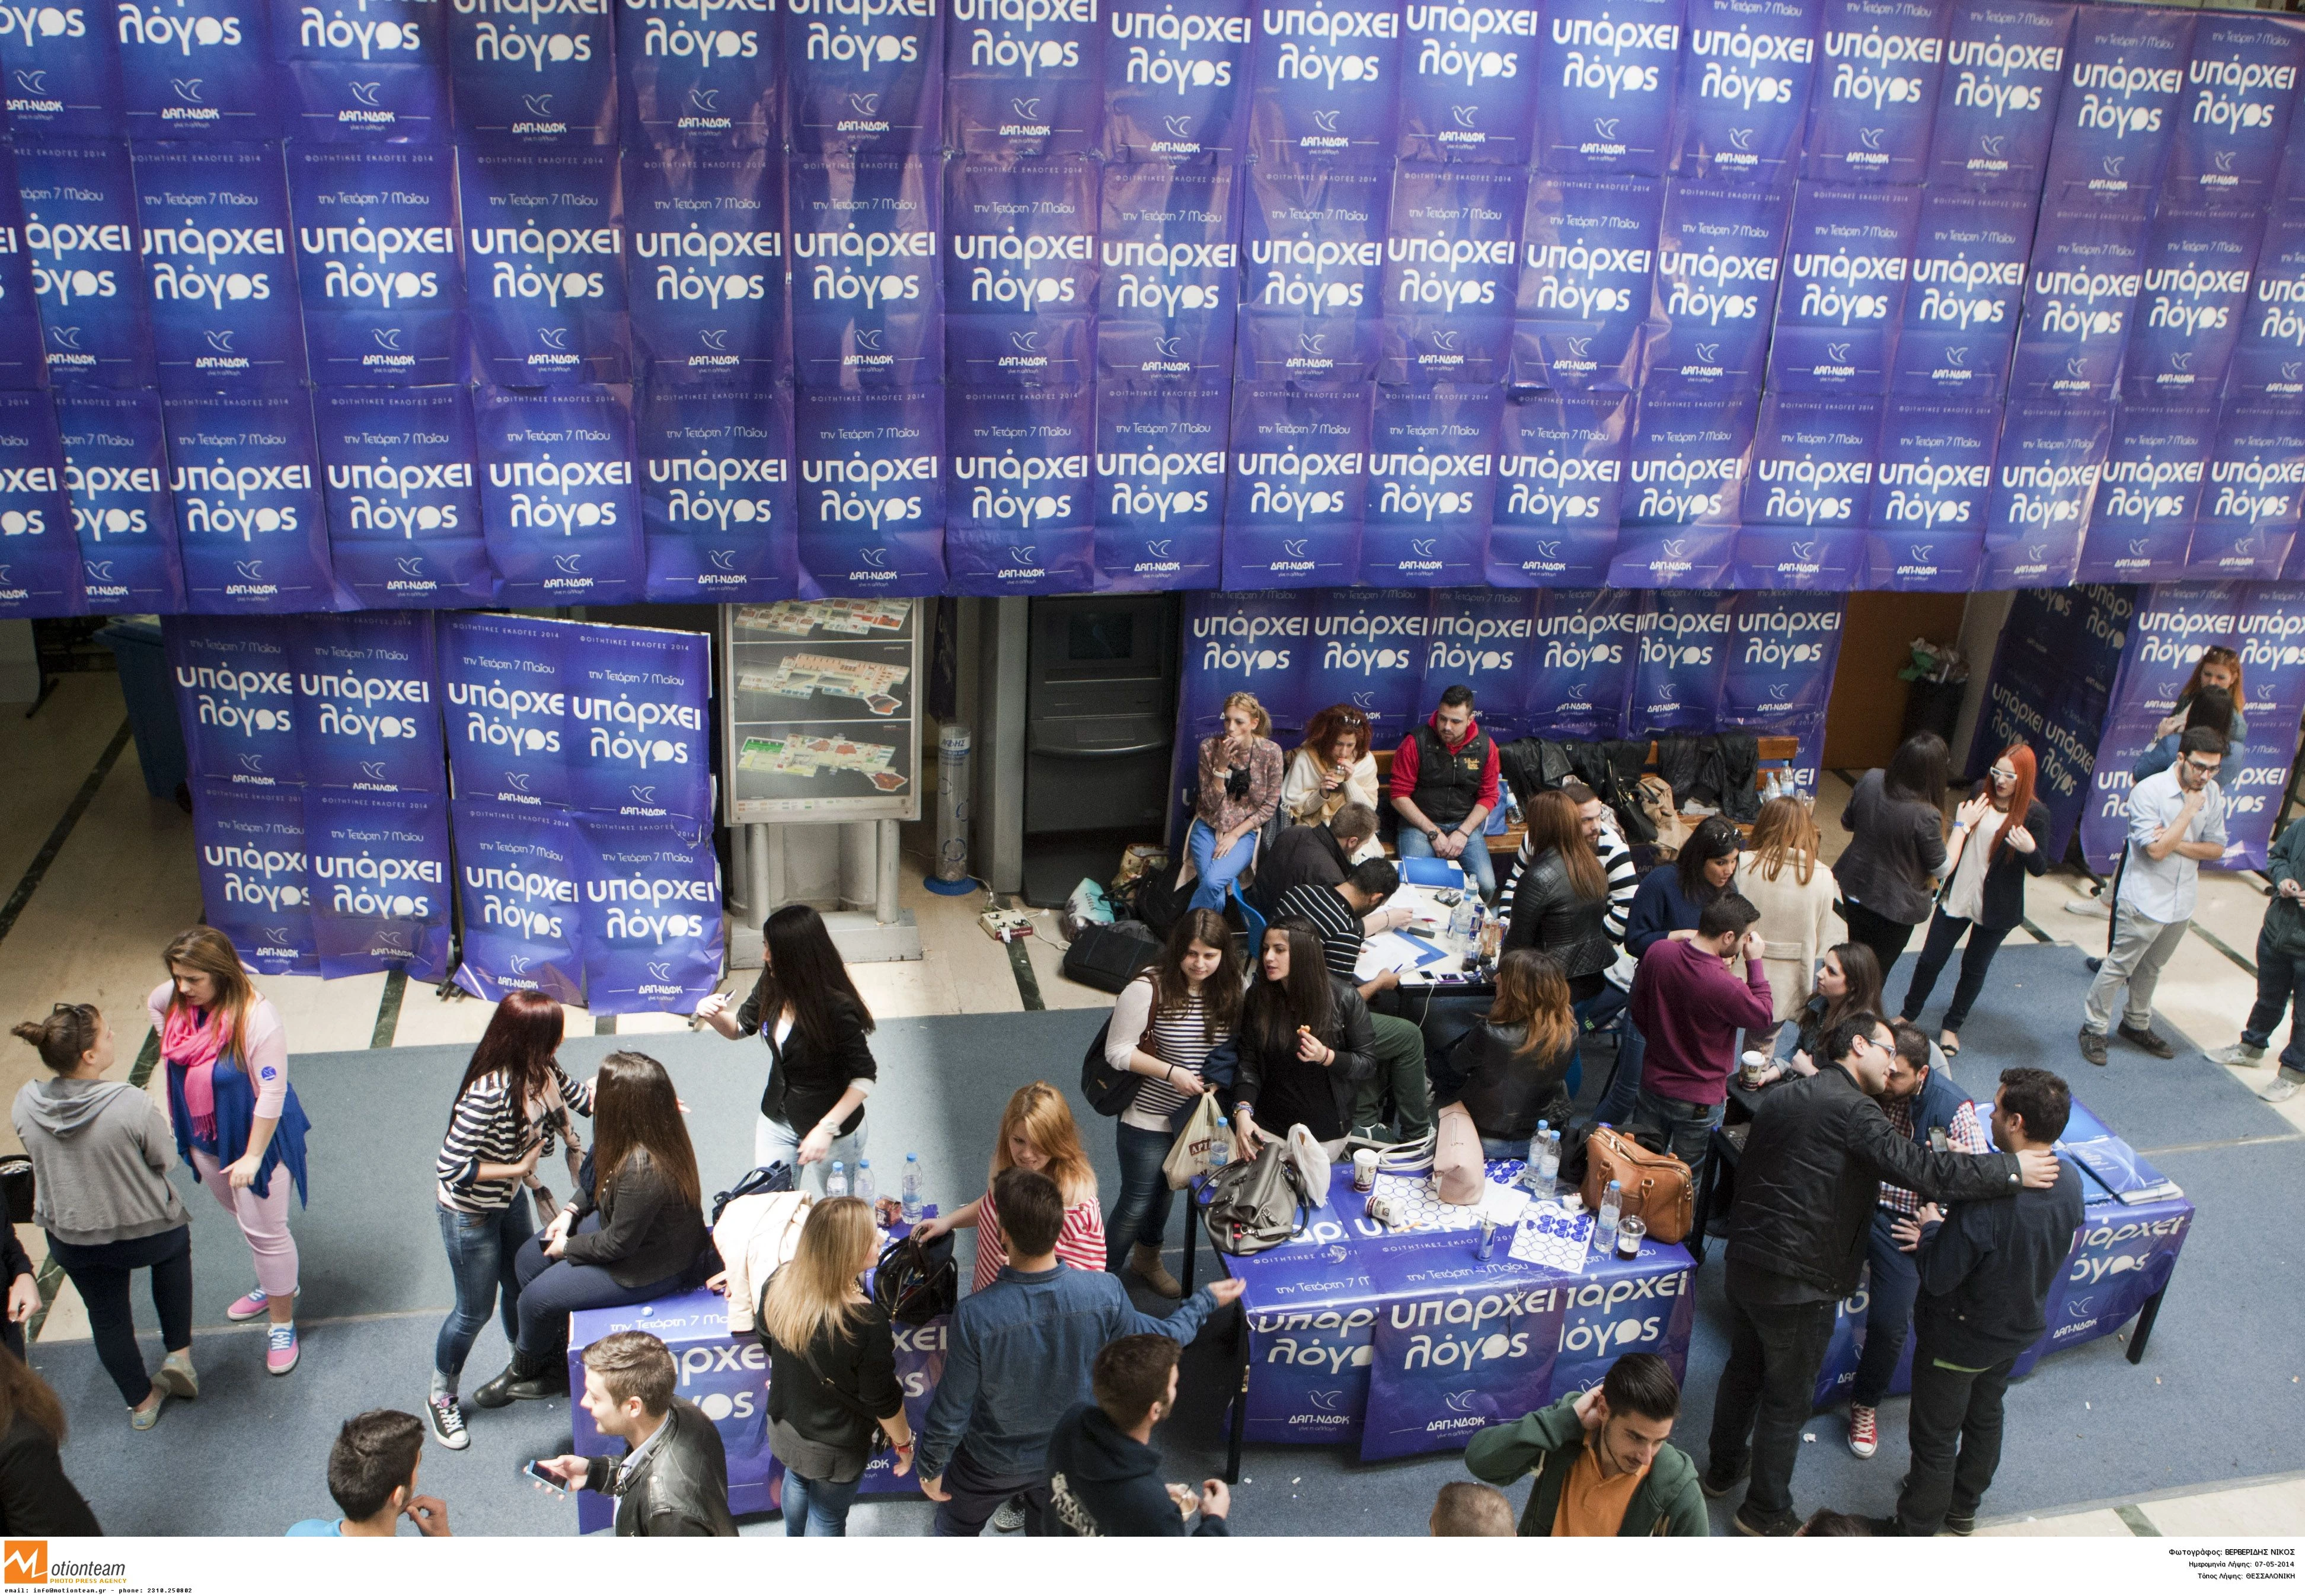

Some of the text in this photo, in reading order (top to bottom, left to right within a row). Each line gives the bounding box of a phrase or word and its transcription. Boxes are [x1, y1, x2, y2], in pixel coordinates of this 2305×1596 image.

[119, 6, 241, 55] λόγος
[302, 7, 420, 59] λόγος
[1112, 5, 1251, 50] υπάρχει
[1407, 0, 1537, 43] υπάρχει
[1419, 39, 1517, 86] λόγος
[1693, 24, 1814, 68] υπάρχει
[1949, 34, 2063, 77] υπάρχει
[1127, 47, 1231, 94] λόγος
[1701, 62, 1792, 110] λόγος
[2190, 55, 2296, 95] υπάρχει
[1955, 72, 2042, 117] λόγος
[2194, 91, 2274, 134] λόγος
[318, 196, 336, 204] την
[381, 191, 388, 203] 7
[1179, 210, 1186, 221] 7
[301, 218, 453, 263] υπάρχει
[637, 223, 780, 266] υπάρχει
[955, 226, 1092, 270] υπάρχει
[1103, 233, 1237, 276] υπάρχει
[1528, 238, 1650, 280] υπάρχει
[325, 261, 438, 308] λόγος
[657, 265, 764, 309] λόγος
[1793, 247, 1907, 288] υπάρχει
[2145, 262, 2249, 299] υπάρχει
[972, 267, 1074, 311] λόγος
[1118, 274, 1219, 317] λόγος
[1537, 275, 1630, 318] λόγος
[1801, 283, 1888, 325] λόγος
[2150, 297, 2229, 336] λόγος
[1030, 426, 1036, 436] 7
[1311, 423, 1318, 433] 7
[328, 457, 472, 499] υπάρχει
[956, 449, 1087, 489] υπάρχει
[1238, 445, 1362, 484] υπάρχει
[1369, 446, 1491, 484] υπάρχει
[1759, 454, 1872, 492] υπάρχει
[2102, 455, 2204, 490] υπάρχει
[351, 496, 458, 538] λόγος
[973, 486, 1071, 528] λόγος
[1251, 482, 1344, 522] λόγος
[1381, 482, 1473, 521] λόγος
[1766, 487, 1852, 525] λόγος
[2107, 487, 2184, 524] λόγος
[1194, 610, 1308, 643] υπάρχει
[1315, 609, 1428, 643] υπάρχει
[1738, 606, 1841, 638] υπάρχει
[2139, 607, 2236, 639] υπάρχει
[1204, 642, 1290, 676] λόγος
[1324, 641, 1409, 675] λόγος
[1745, 637, 1822, 669] λόγος
[589, 671, 603, 679] την
[643, 673, 649, 682] 7
[449, 679, 564, 719] υπάρχε
[573, 694, 701, 732] υπάρχει
[1992, 683, 2044, 733] υπάρχει
[468, 712, 560, 756] λόγος
[591, 727, 688, 768] λόγος
[2046, 721, 2096, 775] υπάρχει
[316, 851, 442, 888] υπάρχει
[655, 852, 659, 861] 7
[334, 885, 428, 919] λόγος
[588, 872, 714, 908] υπάρχει
[607, 908, 703, 944] λόγος
[1297, 1282, 1345, 1292] Τετάρτη
[1346, 1278, 1353, 1287] 7
[1427, 1269, 1474, 1279] Τετάρτη
[1566, 1273, 1688, 1314] άρχει
[1391, 1287, 1557, 1330] υπάρχει
[1268, 1338, 1374, 1374] λόγο
[1404, 1333, 1530, 1370] λόγος
[1288, 1415, 1349, 1424] ΔΑΠ-ΝΔΦΚ
[1426, 1416, 1486, 1431] ΔΑΠ-ΝΔΦΚ
